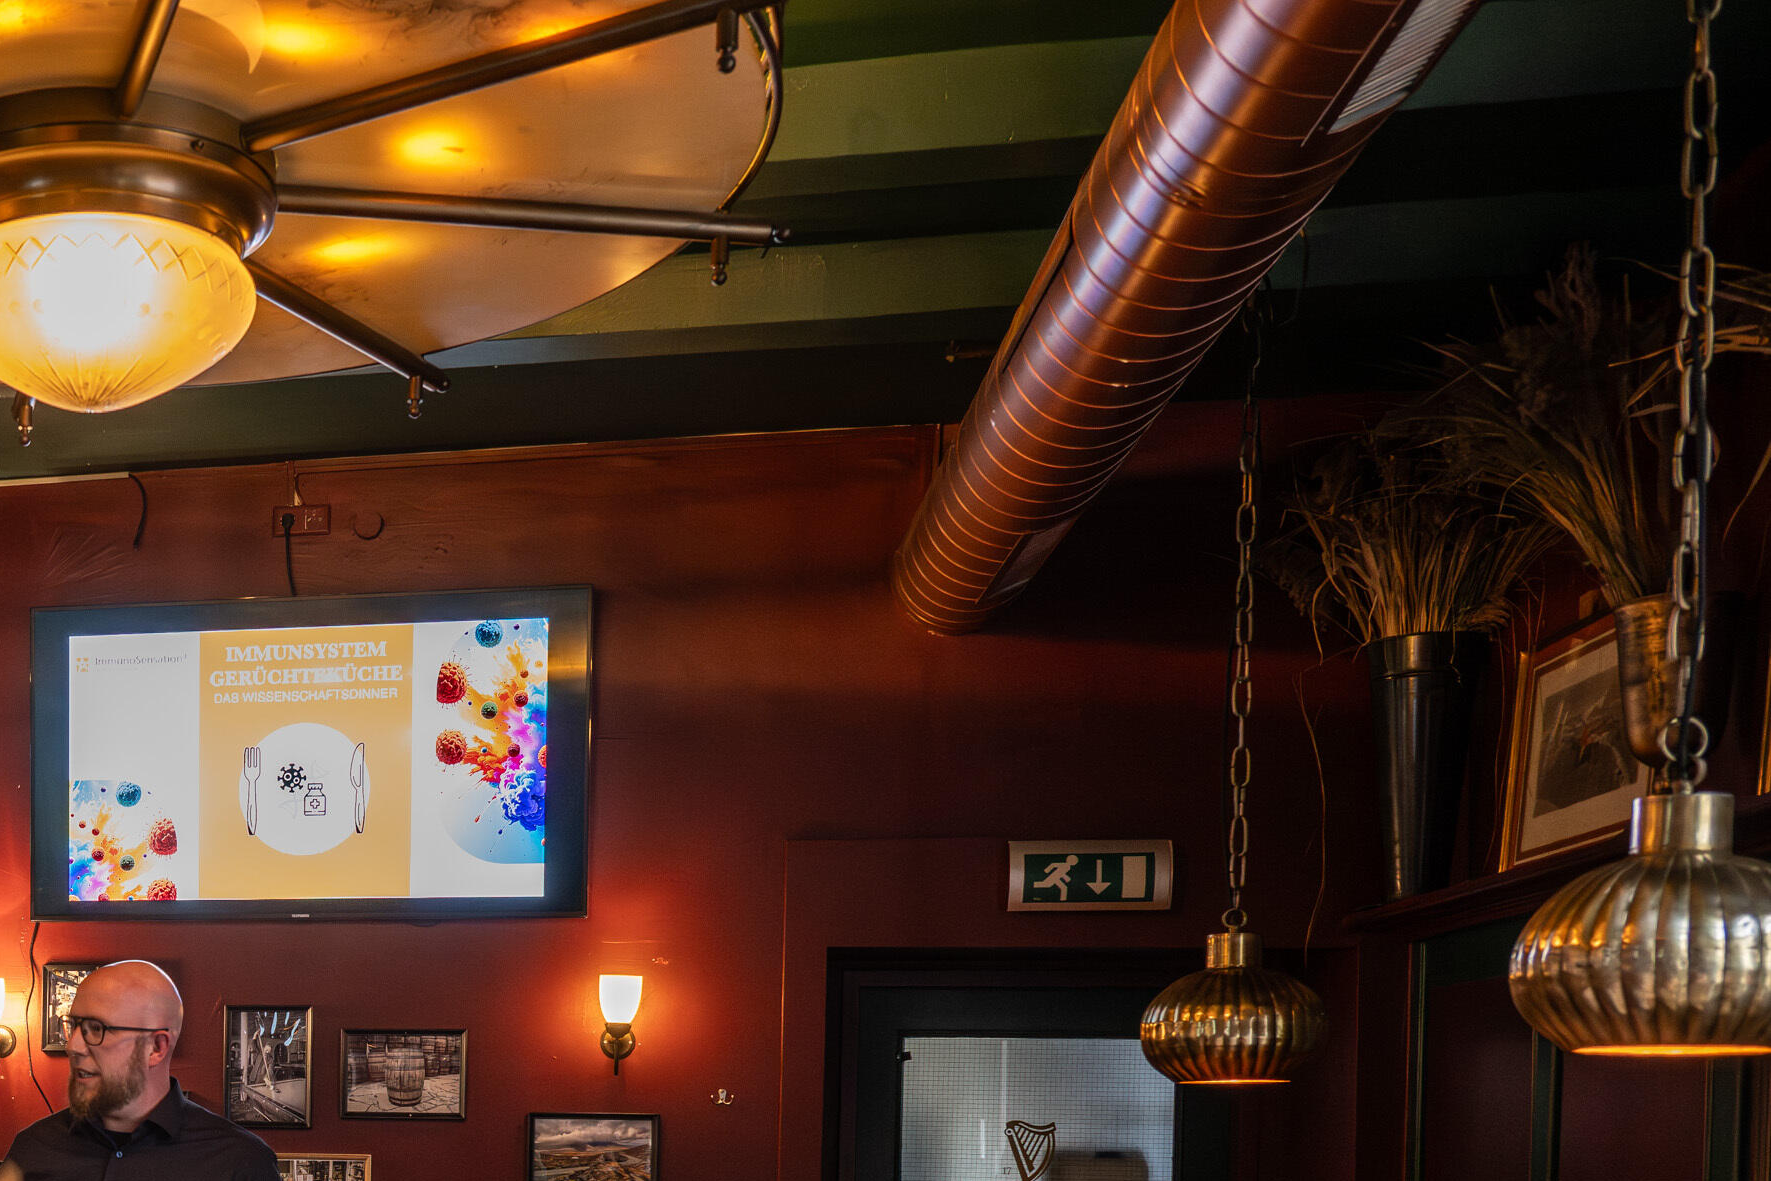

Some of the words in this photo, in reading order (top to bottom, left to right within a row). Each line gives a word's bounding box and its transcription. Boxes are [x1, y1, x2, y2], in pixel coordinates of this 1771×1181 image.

[225, 641, 387, 662] IMMUNSYSTEM
[209, 663, 403, 687] GERÜCHTEKÜCHE
[214, 692, 239, 704] DAS
[242, 687, 398, 703] WISSENSCHAFTSDINNER
